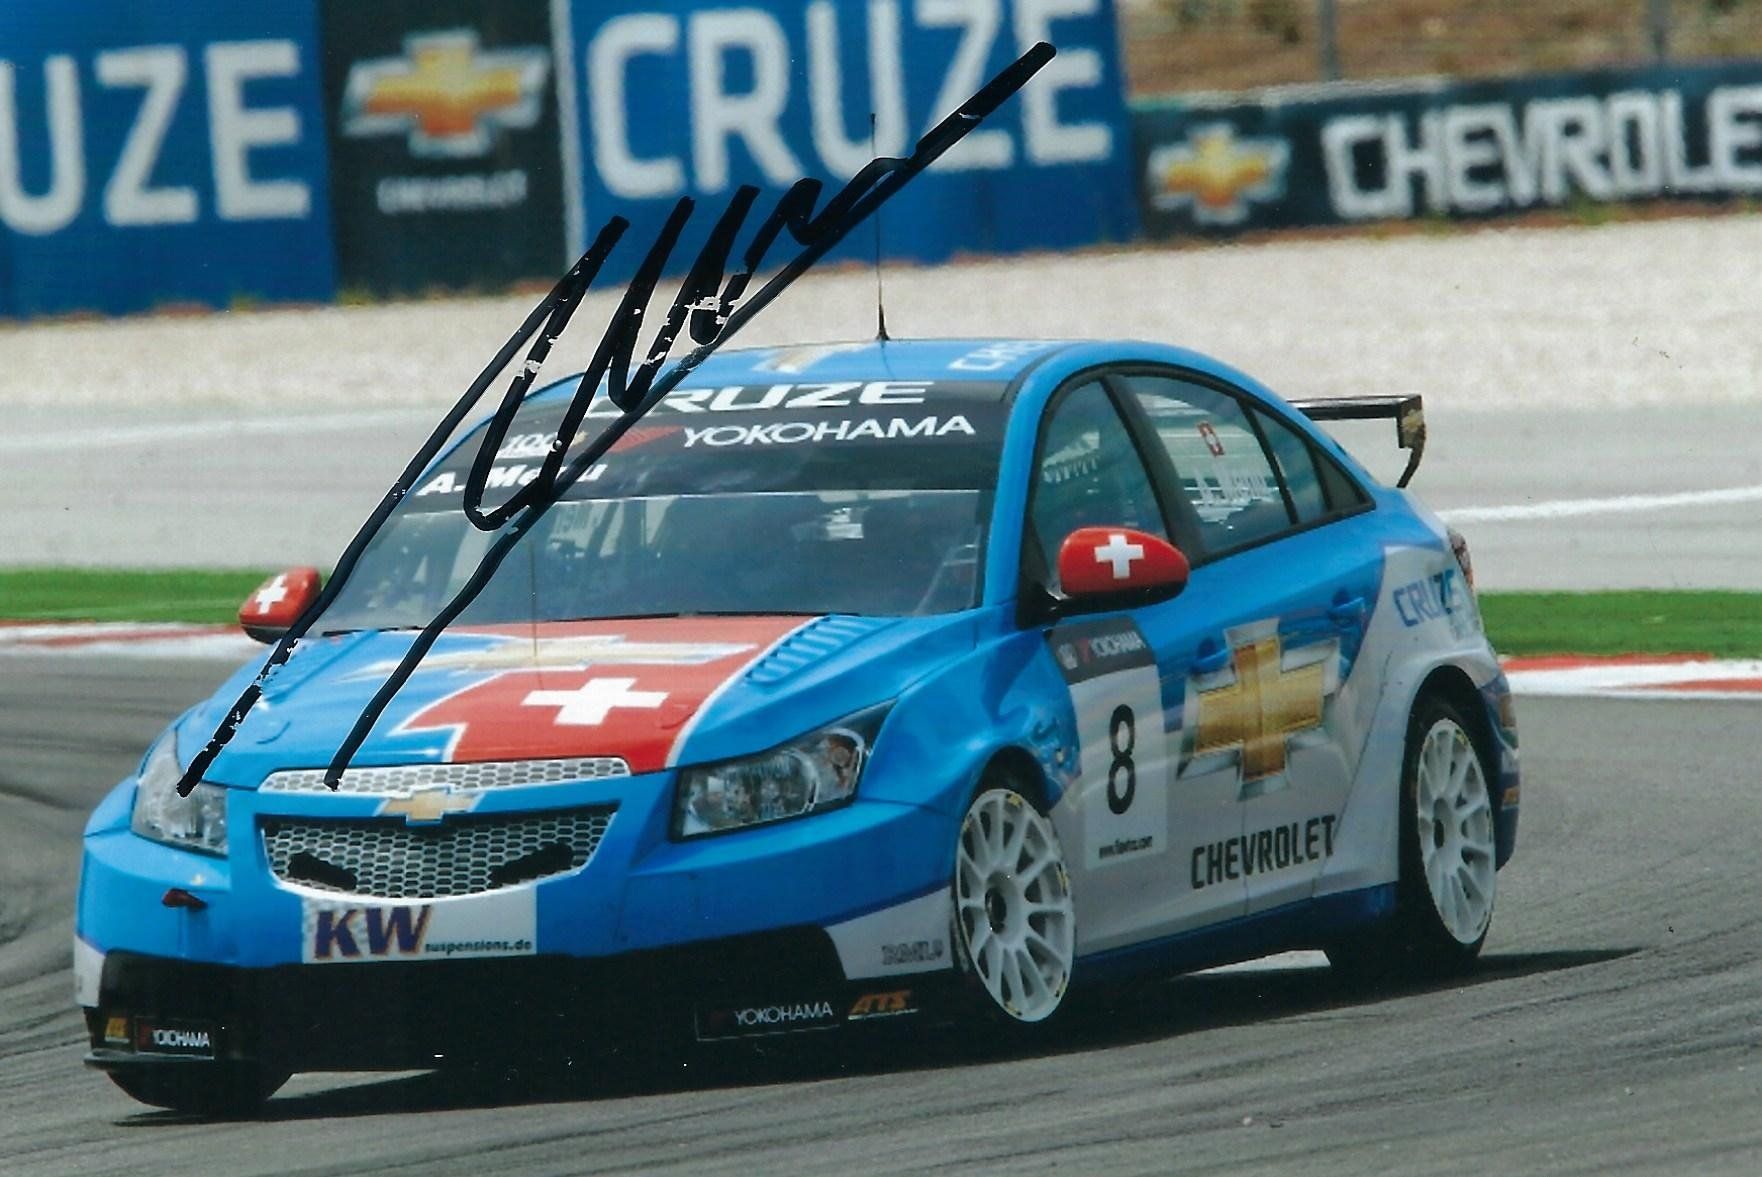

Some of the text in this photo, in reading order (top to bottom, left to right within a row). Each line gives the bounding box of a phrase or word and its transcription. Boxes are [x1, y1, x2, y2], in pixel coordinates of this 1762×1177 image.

[586, 0, 1112, 198] CRUZE
[683, 415, 976, 448] YOKOHAMA
[1106, 704, 1136, 815] 8
[1191, 815, 1336, 889] CHEVROLET
[314, 904, 433, 960] KW
[735, 1001, 834, 1025] YOKOHAMA
